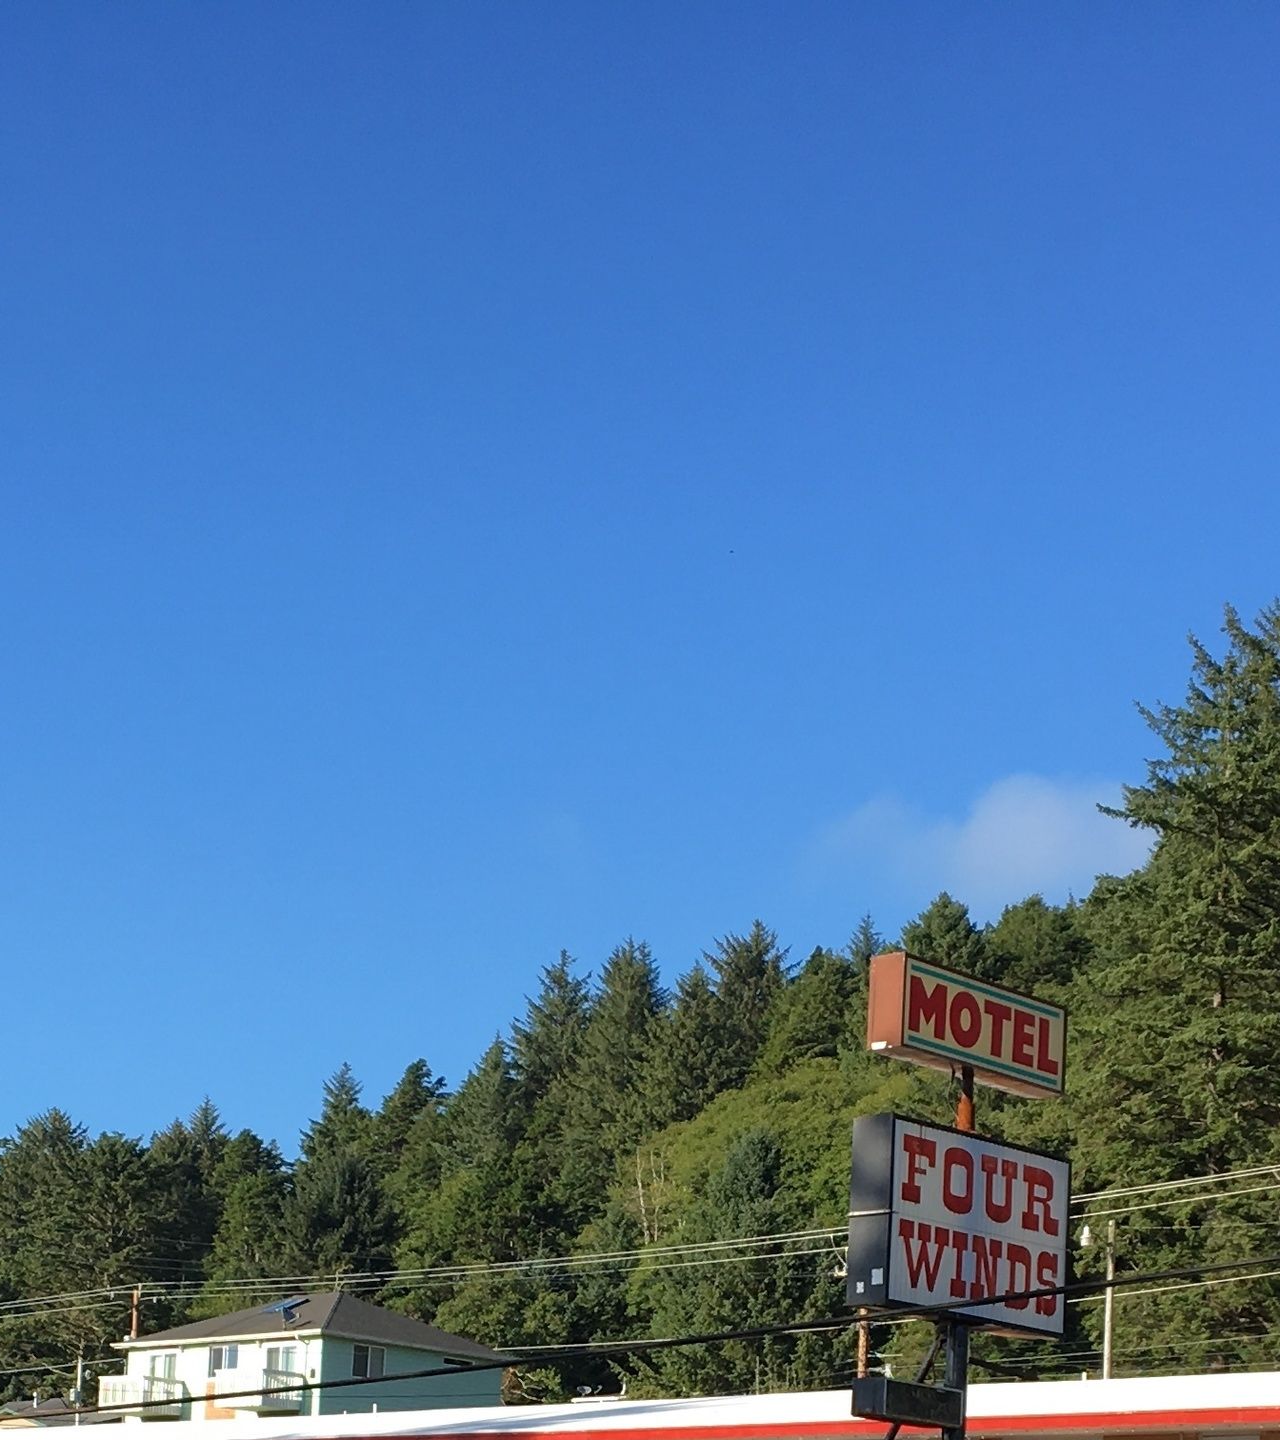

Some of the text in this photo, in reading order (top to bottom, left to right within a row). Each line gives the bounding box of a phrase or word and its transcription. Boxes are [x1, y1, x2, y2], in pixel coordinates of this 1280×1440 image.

[908, 975, 1058, 1076] MOTEL
[901, 1133, 1060, 1237] FOUR
[898, 1218, 1059, 1317] WINDS
